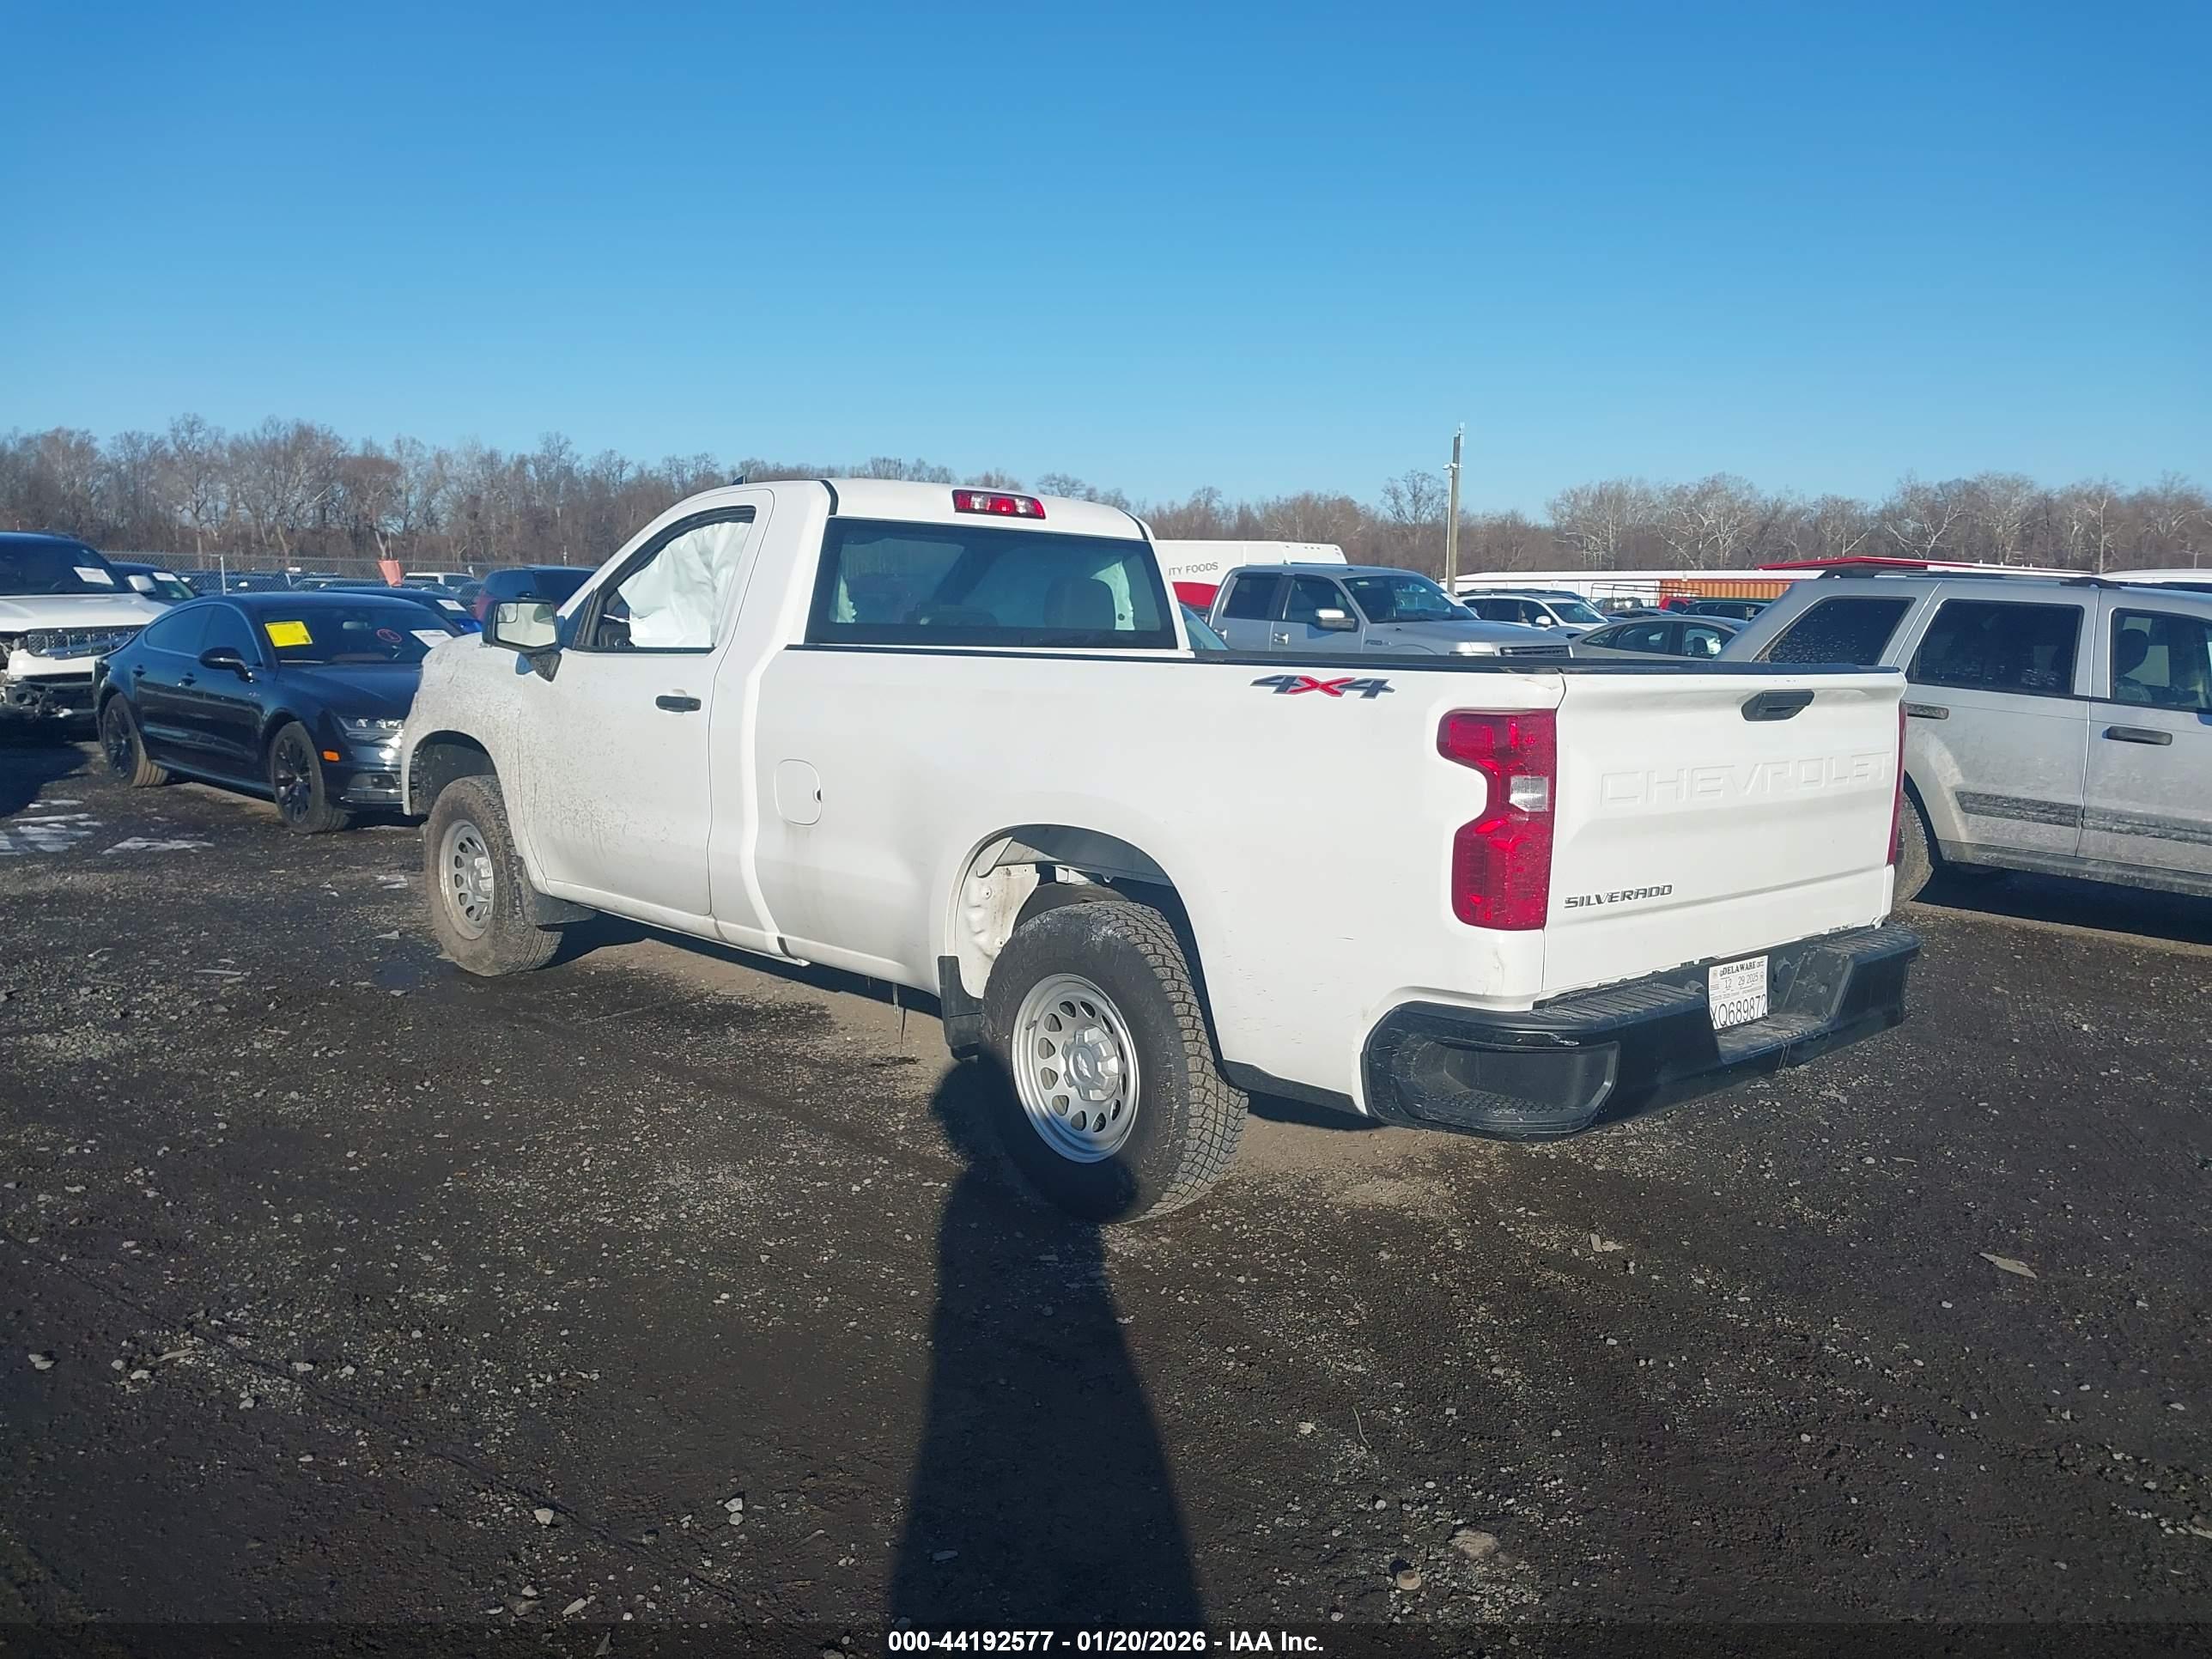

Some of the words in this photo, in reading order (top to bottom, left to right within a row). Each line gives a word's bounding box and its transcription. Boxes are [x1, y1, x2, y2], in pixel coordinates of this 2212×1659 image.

[1186, 562, 1218, 574] FOODS
[1601, 750, 1892, 805] CHEVROLET
[1565, 884, 1673, 908] SILVERADO
[1723, 961, 1757, 975] DELAWARE
[1711, 994, 1766, 1029] XQ689872
